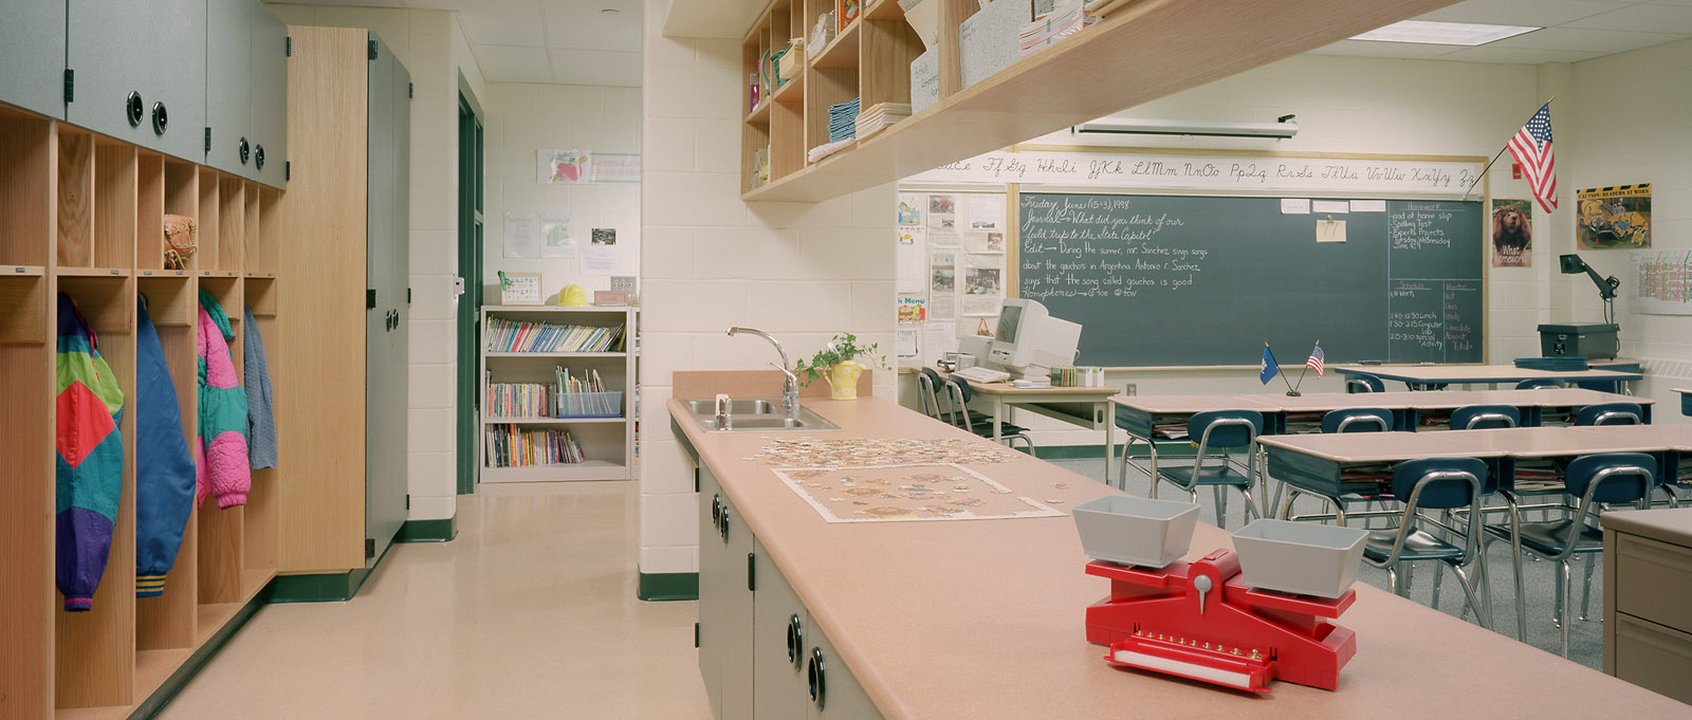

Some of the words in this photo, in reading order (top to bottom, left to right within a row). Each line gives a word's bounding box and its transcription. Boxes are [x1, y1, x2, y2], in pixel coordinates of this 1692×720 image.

[1095, 213, 1110, 224] did
[1111, 217, 1128, 230] you
[1129, 214, 1153, 225] think
[1154, 213, 1167, 231] of
[1166, 218, 1184, 226] our
[1407, 212, 1414, 220] at
[1417, 211, 1435, 219] home
[1438, 211, 1452, 222] slip
[1417, 218, 1432, 227] Test
[1069, 228, 1079, 239] to
[1079, 228, 1096, 239] the
[1418, 228, 1445, 239] Projects
[1085, 241, 1096, 254] the
[1191, 248, 1208, 260] songs
[1023, 259, 1041, 270] about
[1045, 259, 1057, 270] the
[1024, 278, 1041, 290] says
[1044, 274, 1061, 285] that
[1065, 273, 1081, 285] the
[1082, 278, 1100, 290] song
[1102, 275, 1122, 285] called
[1172, 273, 1193, 290] good
